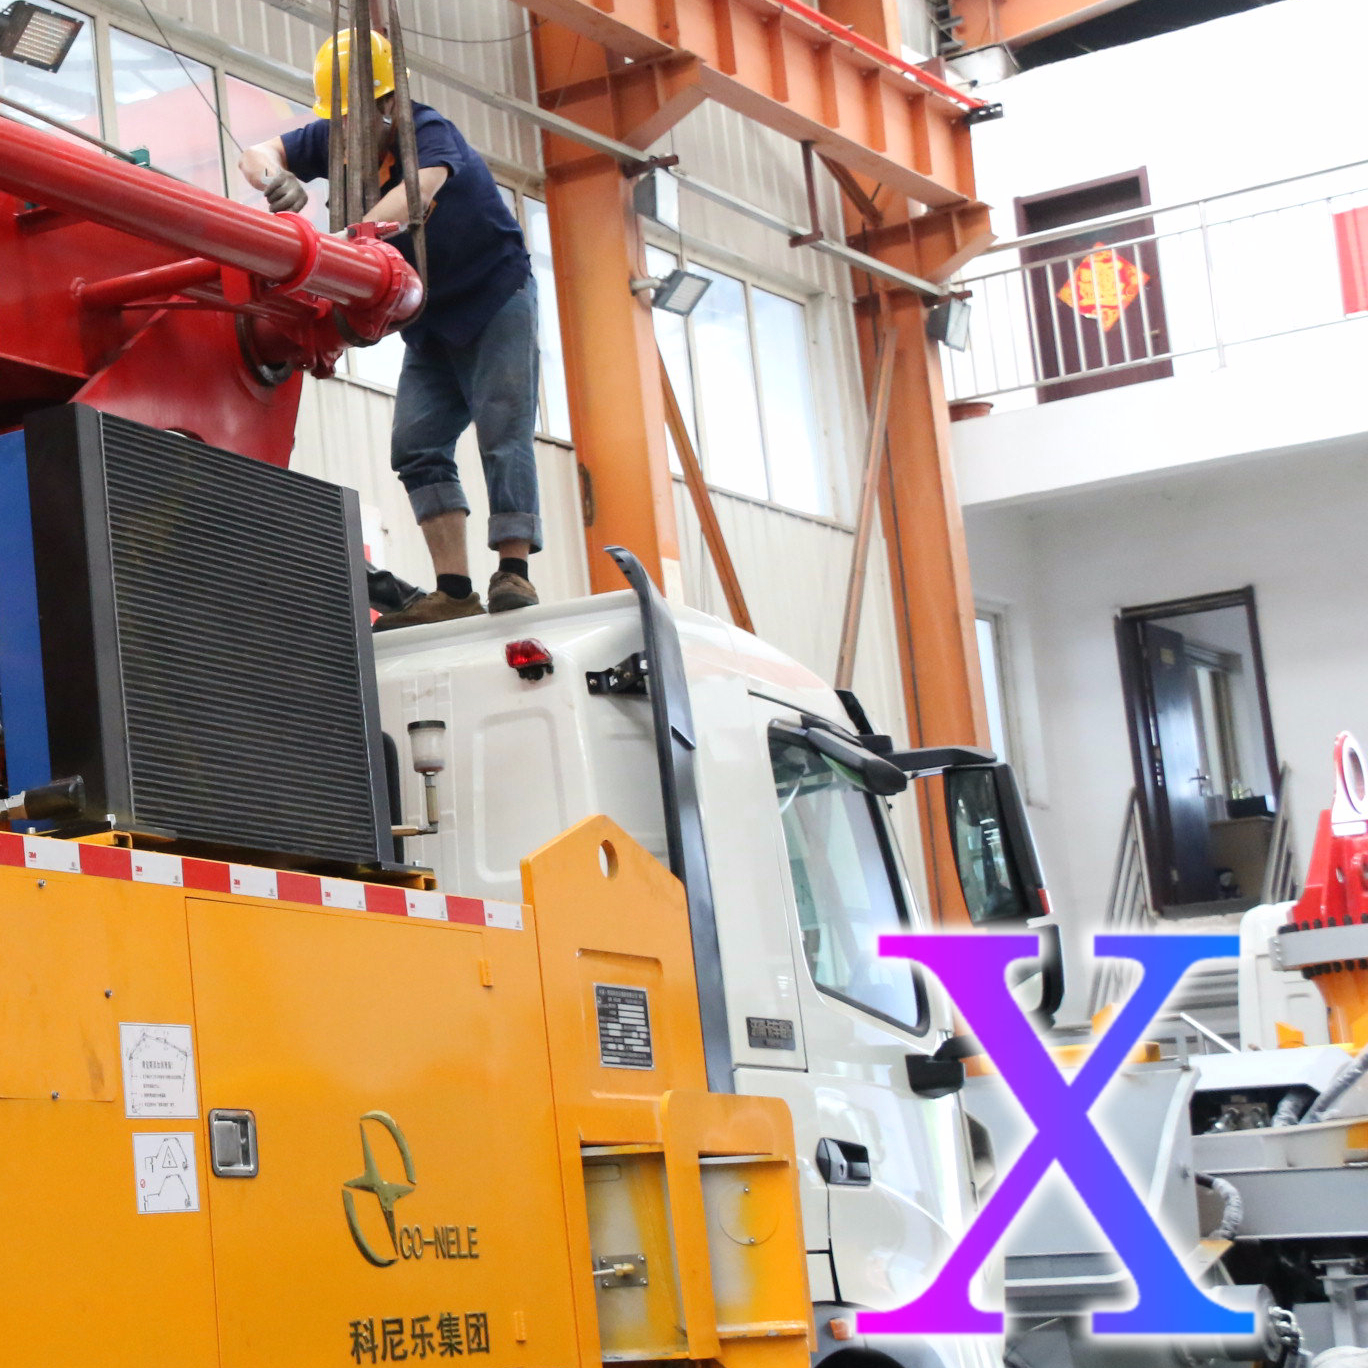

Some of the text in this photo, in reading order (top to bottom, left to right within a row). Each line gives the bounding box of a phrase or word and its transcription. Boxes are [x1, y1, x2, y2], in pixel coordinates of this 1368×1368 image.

[28, 851, 37, 859] 3M
[135, 865, 143, 873] 3M
[400, 1223, 479, 1260] CO-NELE
[349, 1312, 490, 1365] 科尼乐集团
